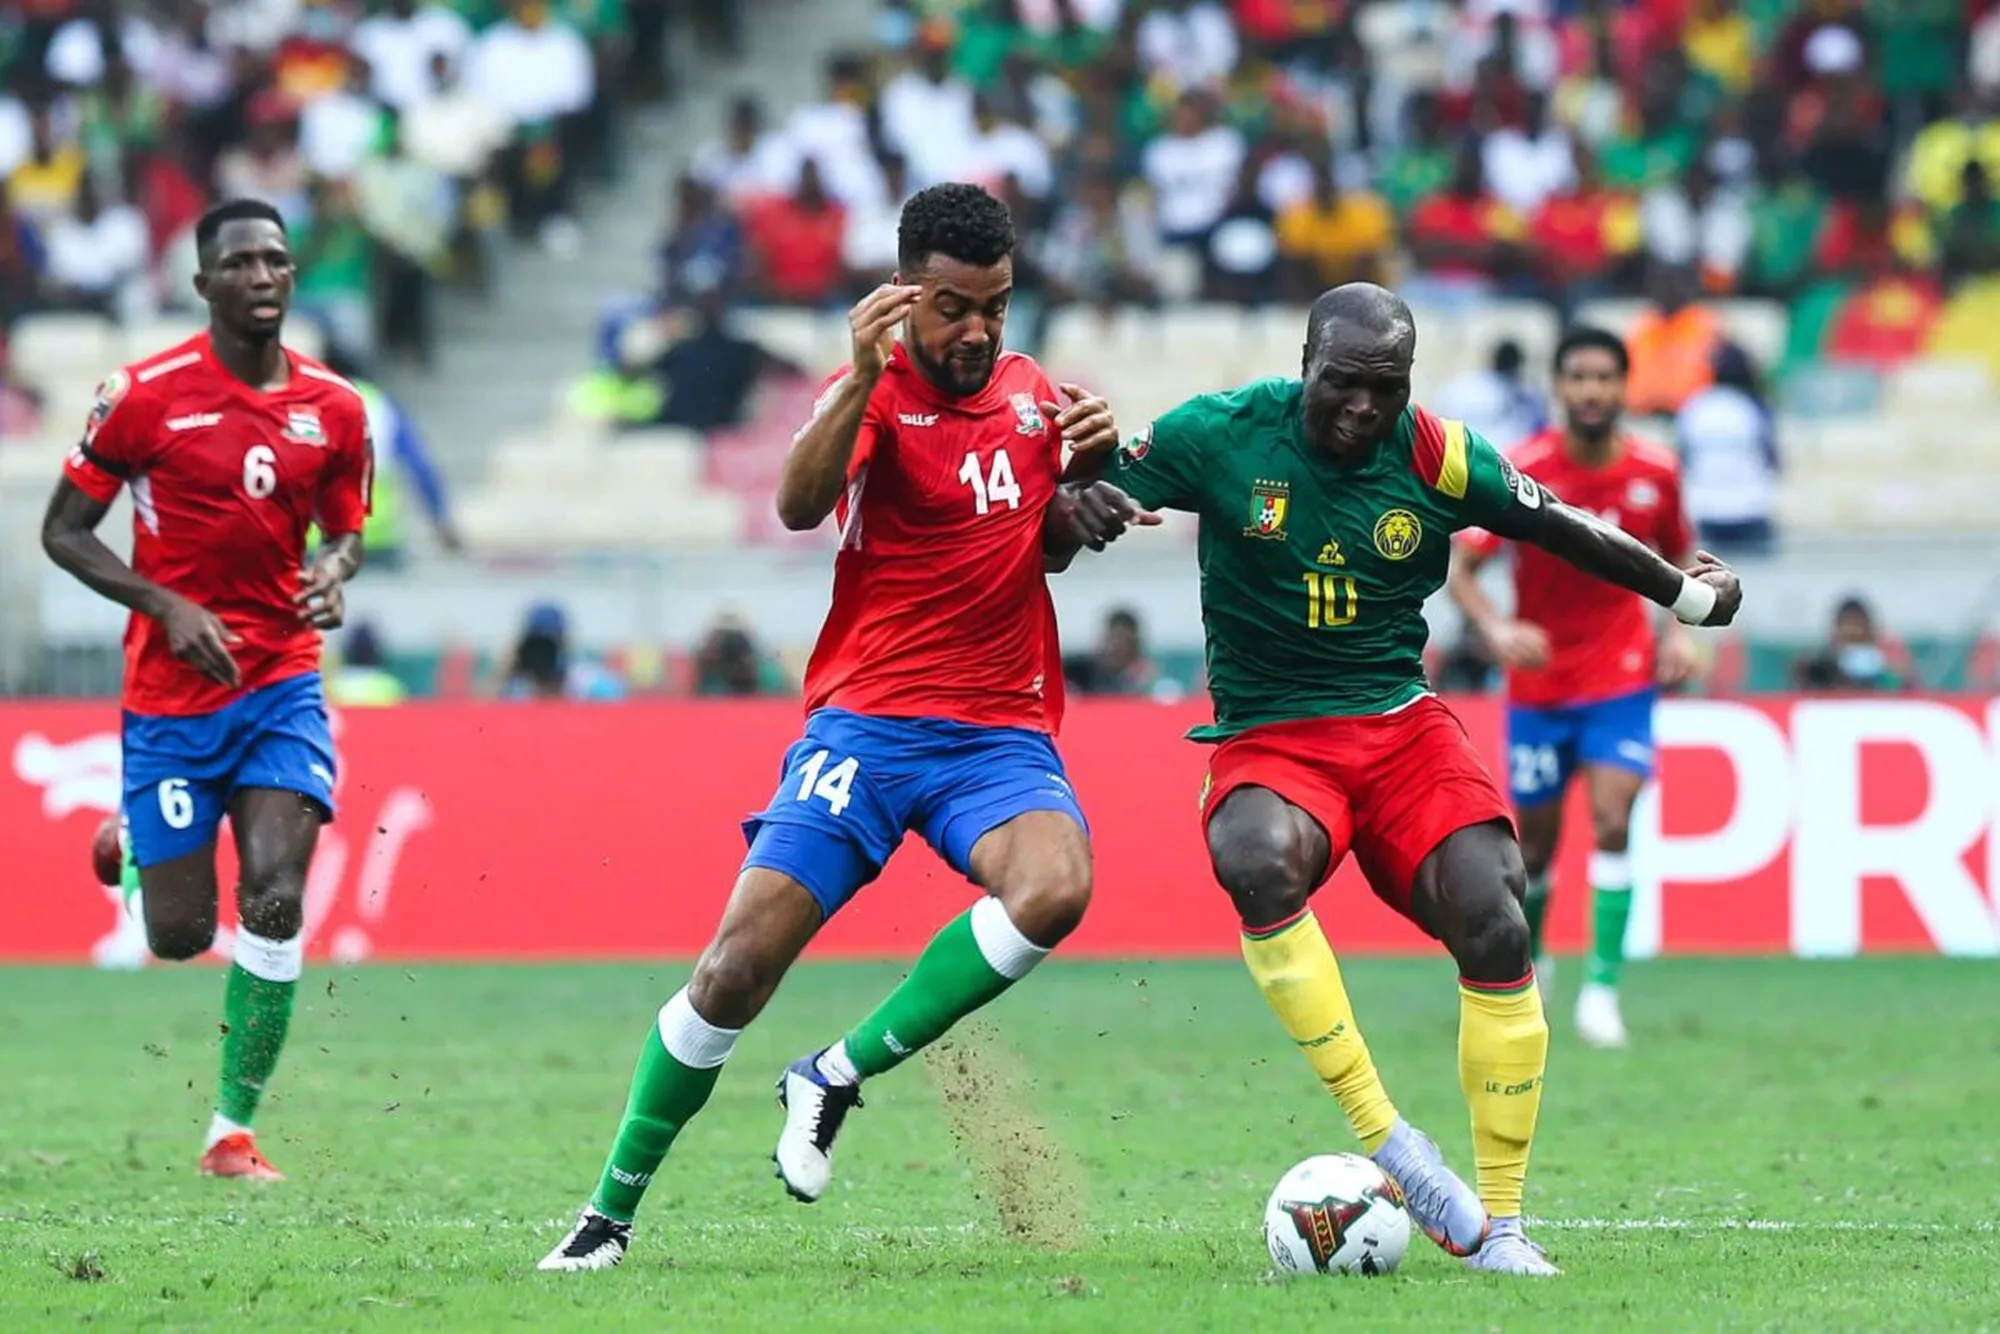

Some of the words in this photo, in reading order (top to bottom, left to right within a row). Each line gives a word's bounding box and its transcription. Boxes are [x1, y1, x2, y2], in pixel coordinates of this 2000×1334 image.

[243, 444, 276, 499] 6
[958, 449, 1022, 515] 14
[1303, 572, 1358, 629] 10
[158, 777, 194, 829] 6
[796, 749, 860, 816] 14
[1620, 699, 2000, 960] PR
